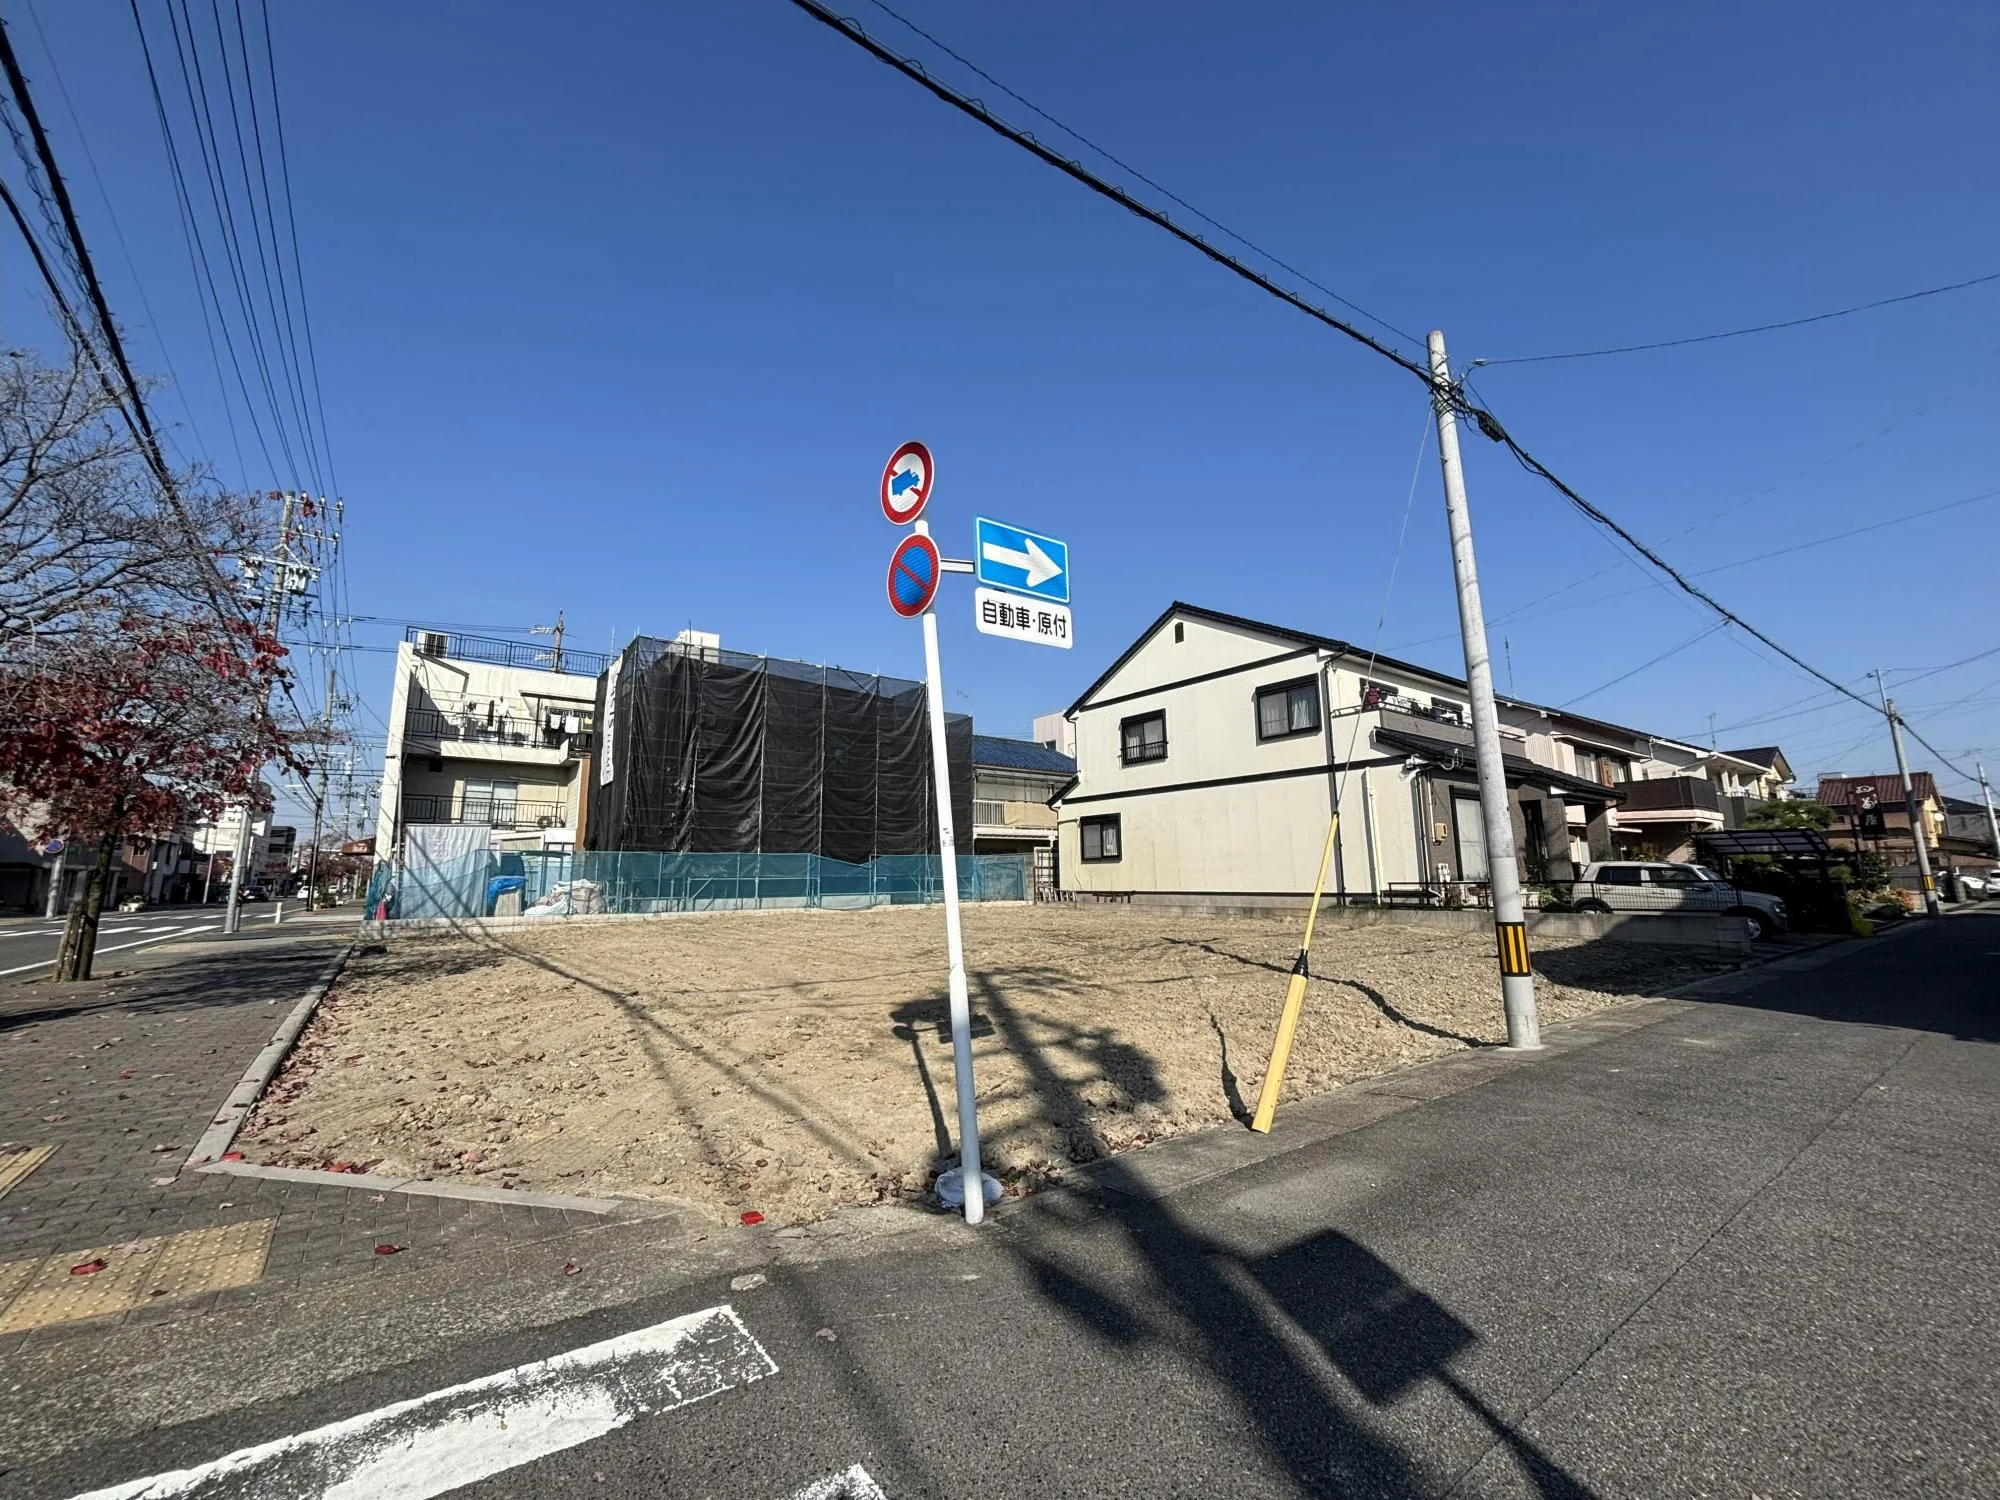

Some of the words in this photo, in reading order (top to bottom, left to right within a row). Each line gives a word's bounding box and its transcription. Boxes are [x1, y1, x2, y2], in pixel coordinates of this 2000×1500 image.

[983, 599, 1067, 638] 自動車・原付
